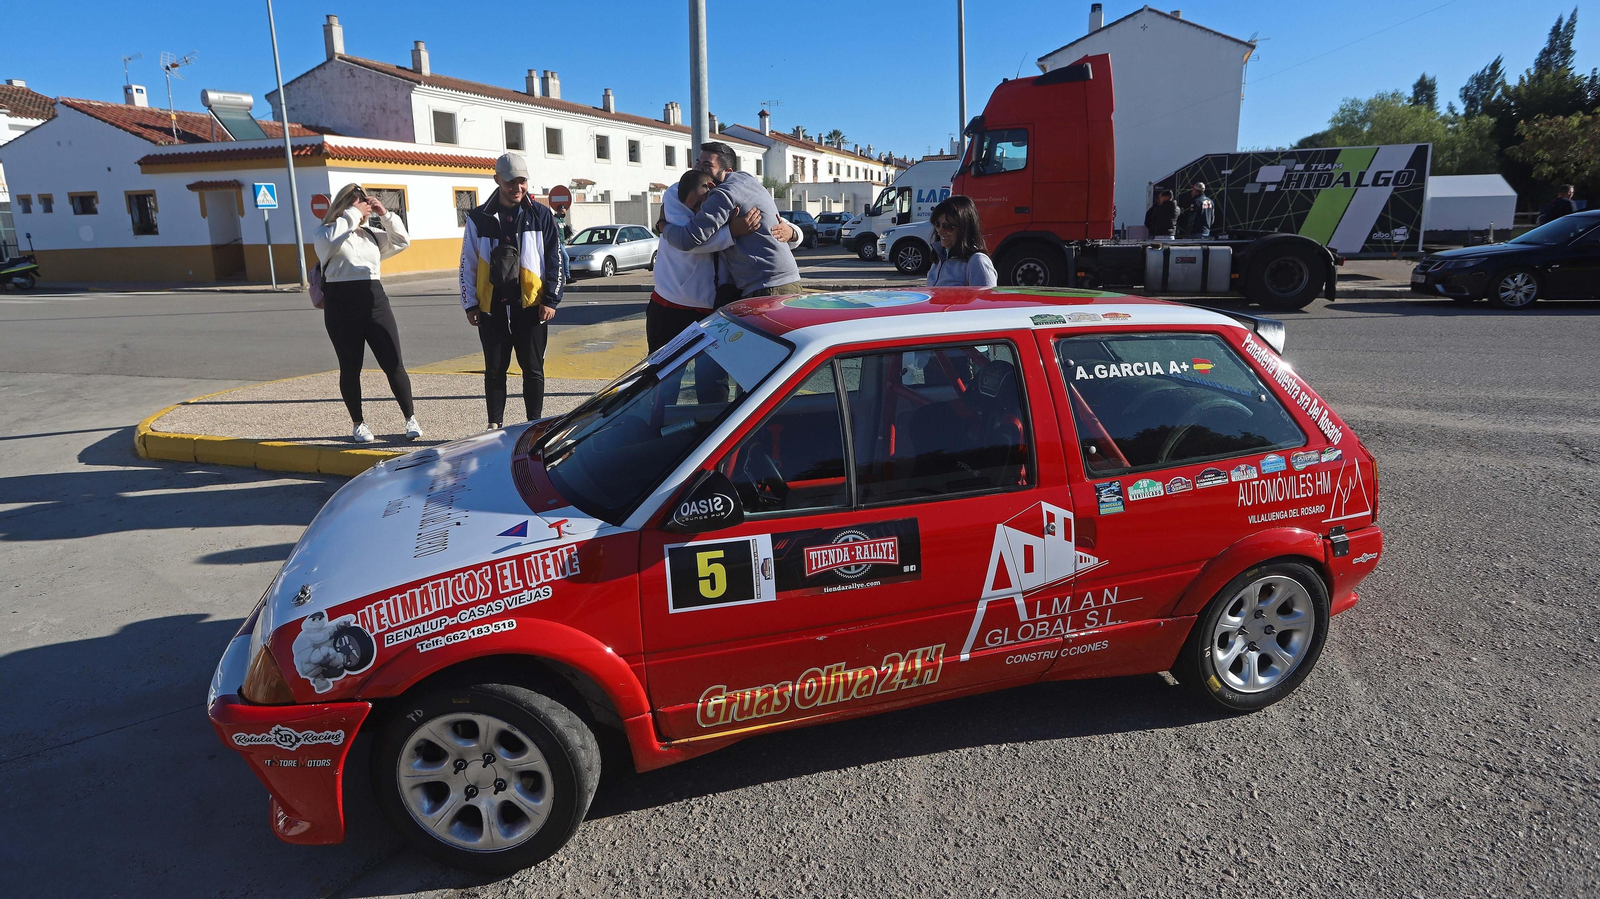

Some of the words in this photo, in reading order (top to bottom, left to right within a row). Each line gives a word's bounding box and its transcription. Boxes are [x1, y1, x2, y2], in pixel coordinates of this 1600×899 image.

[1281, 169, 1416, 190] HIDALGO
[1075, 362, 1165, 380] A.GARCIA
[1169, 360, 1189, 374] A+
[1273, 368, 1301, 400] Nuestra
[1296, 391, 1311, 411] sra
[1307, 398, 1324, 420] Del
[1317, 409, 1342, 445] Rosario
[680, 496, 724, 516] OASIS
[1238, 472, 1314, 507] AUTOMÓVILES
[1316, 471, 1331, 495] HM
[1248, 510, 1288, 524] VILLALUENGA
[1288, 508, 1300, 518] DEL
[1300, 504, 1326, 516] ROSARIO
[495, 559, 523, 594] EL
[523, 543, 581, 588] NENE
[696, 550, 727, 599] 5
[823, 579, 882, 594] tiendarallye.com
[386, 617, 448, 647] BENALUP
[458, 600, 503, 623] CASAS
[505, 586, 553, 608] VIEJAS
[985, 615, 1077, 647] GLOBAL
[1084, 609, 1122, 629] S.L.
[418, 636, 444, 652] Telf:
[445, 630, 469, 644] 662
[469, 625, 492, 639] 183
[492, 619, 516, 634] 518
[697, 681, 793, 727] Gruas
[795, 661, 878, 710] Oliva
[877, 643, 946, 694] 24H
[234, 734, 275, 744] Rotula
[300, 732, 341, 744] Racing
